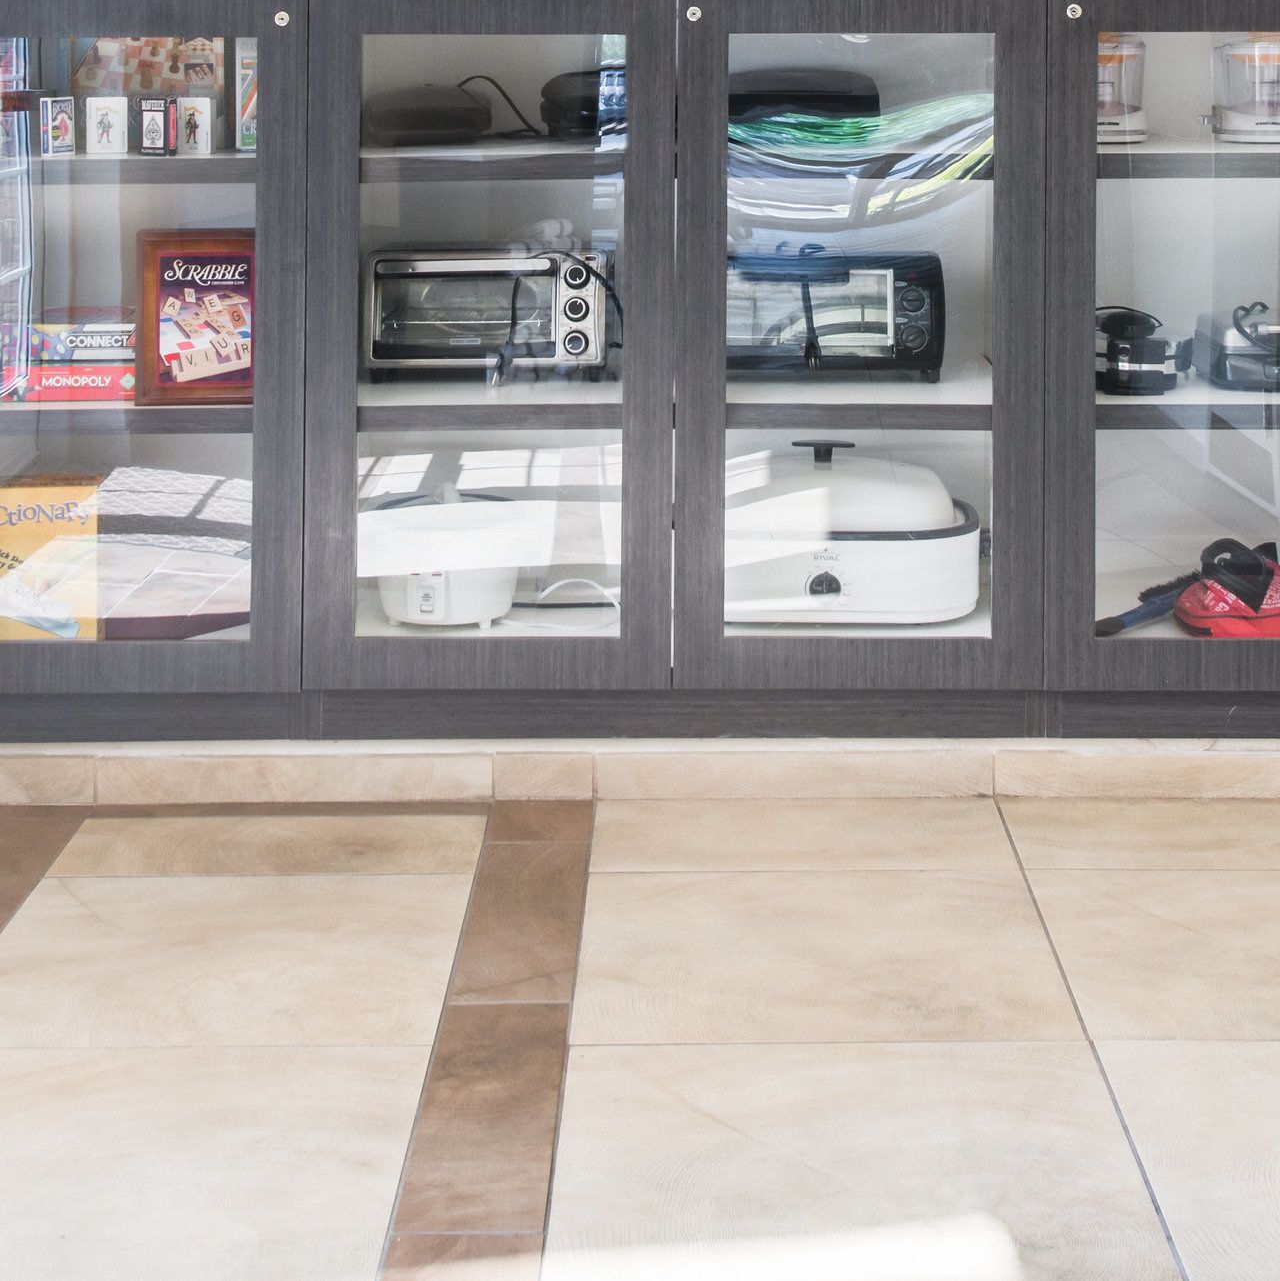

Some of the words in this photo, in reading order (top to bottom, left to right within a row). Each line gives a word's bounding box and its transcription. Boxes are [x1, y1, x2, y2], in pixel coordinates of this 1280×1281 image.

[164, 259, 248, 286] SCRABBLE
[66, 334, 128, 348] CONNECT
[41, 375, 112, 388] MONOPOLY
